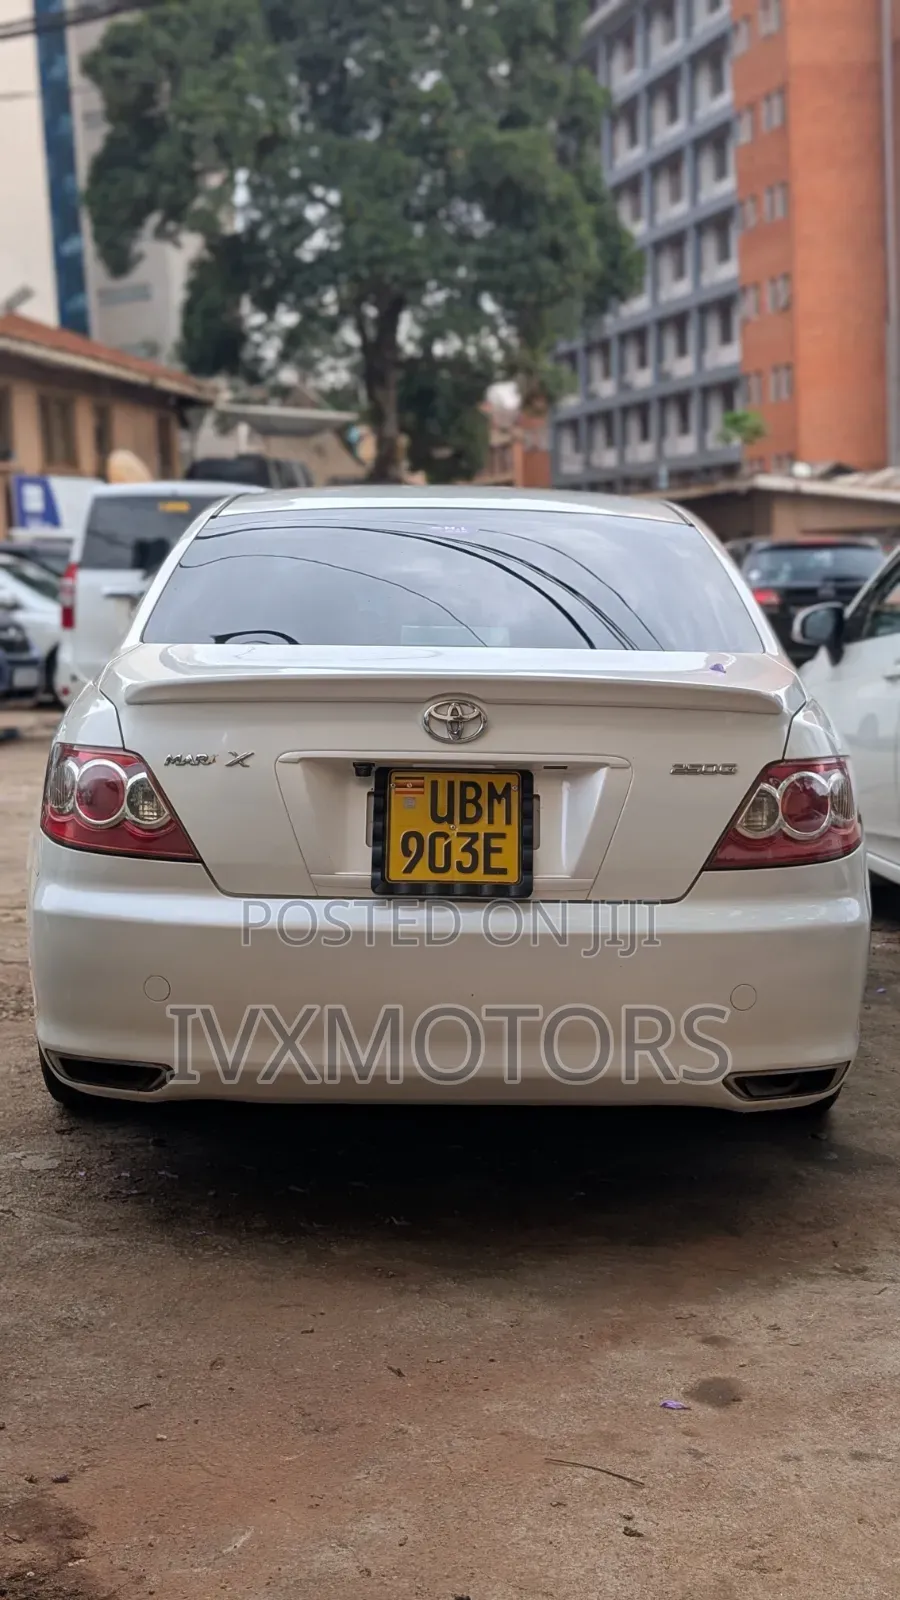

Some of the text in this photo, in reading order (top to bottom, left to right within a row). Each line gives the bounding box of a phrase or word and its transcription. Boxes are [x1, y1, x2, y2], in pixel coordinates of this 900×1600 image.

[224, 751, 255, 768] X
[429, 779, 513, 826] UBM
[400, 830, 508, 875] 903E
